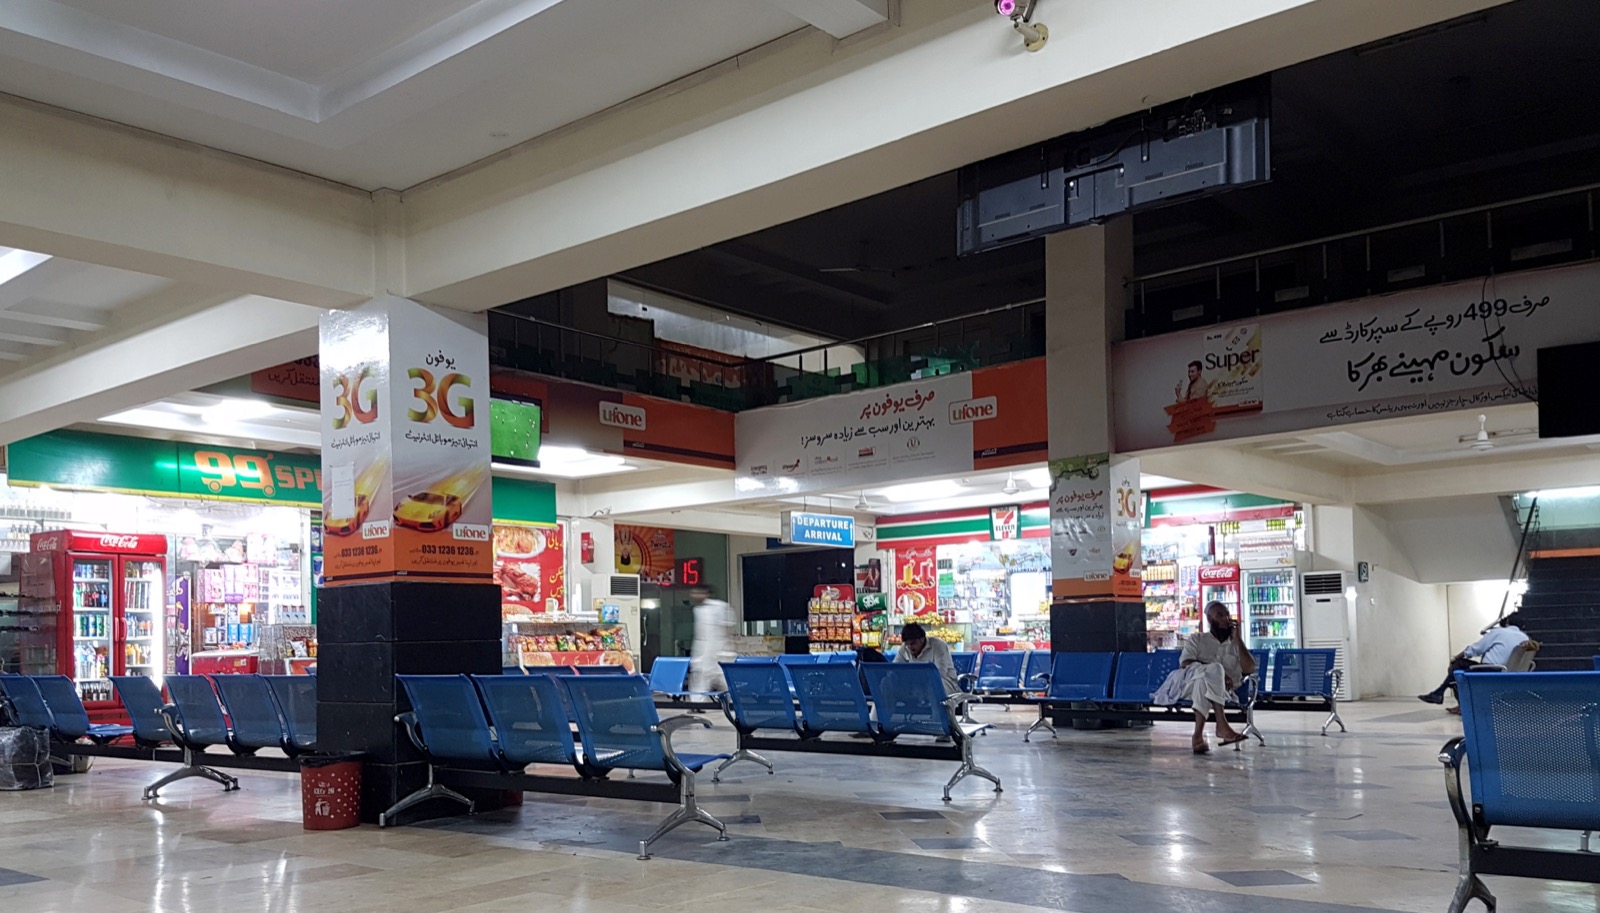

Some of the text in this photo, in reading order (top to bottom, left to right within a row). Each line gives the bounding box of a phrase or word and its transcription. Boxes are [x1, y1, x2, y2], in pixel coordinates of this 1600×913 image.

[1463, 299, 1507, 320] 499
[1509, 296, 1550, 317] صرف
[1400, 308, 1422, 331] کے
[1424, 314, 1462, 335] روپے
[1319, 329, 1342, 344] سے
[426, 350, 456, 370] یوفون
[1205, 349, 1259, 371] Super
[1348, 326, 1520, 391] سکون مہینے بھر کا
[332, 366, 378, 430] 3G
[407, 367, 475, 429] 3G
[859, 389, 935, 419] صرف یوفون پر
[603, 406, 642, 427] ufone
[953, 403, 993, 421] ufone
[854, 426, 867, 437] سے
[868, 425, 889, 437] سب
[890, 418, 902, 434] اور
[903, 416, 935, 431] بہترین
[834, 426, 853, 442] زیادہ
[194, 450, 275, 496] 99
[1117, 488, 1136, 518] 3G
[797, 515, 849, 530] DEPARTURE
[996, 510, 1014, 525] 7
[364, 524, 387, 537] ufone
[455, 526, 486, 539] ufone
[804, 529, 843, 542] ARRIVAL
[422, 544, 436, 554] 033
[438, 545, 455, 555] 1236
[457, 546, 474, 556] 1236
[683, 560, 698, 585] 15
[1201, 567, 1235, 579] Coca-Cola
